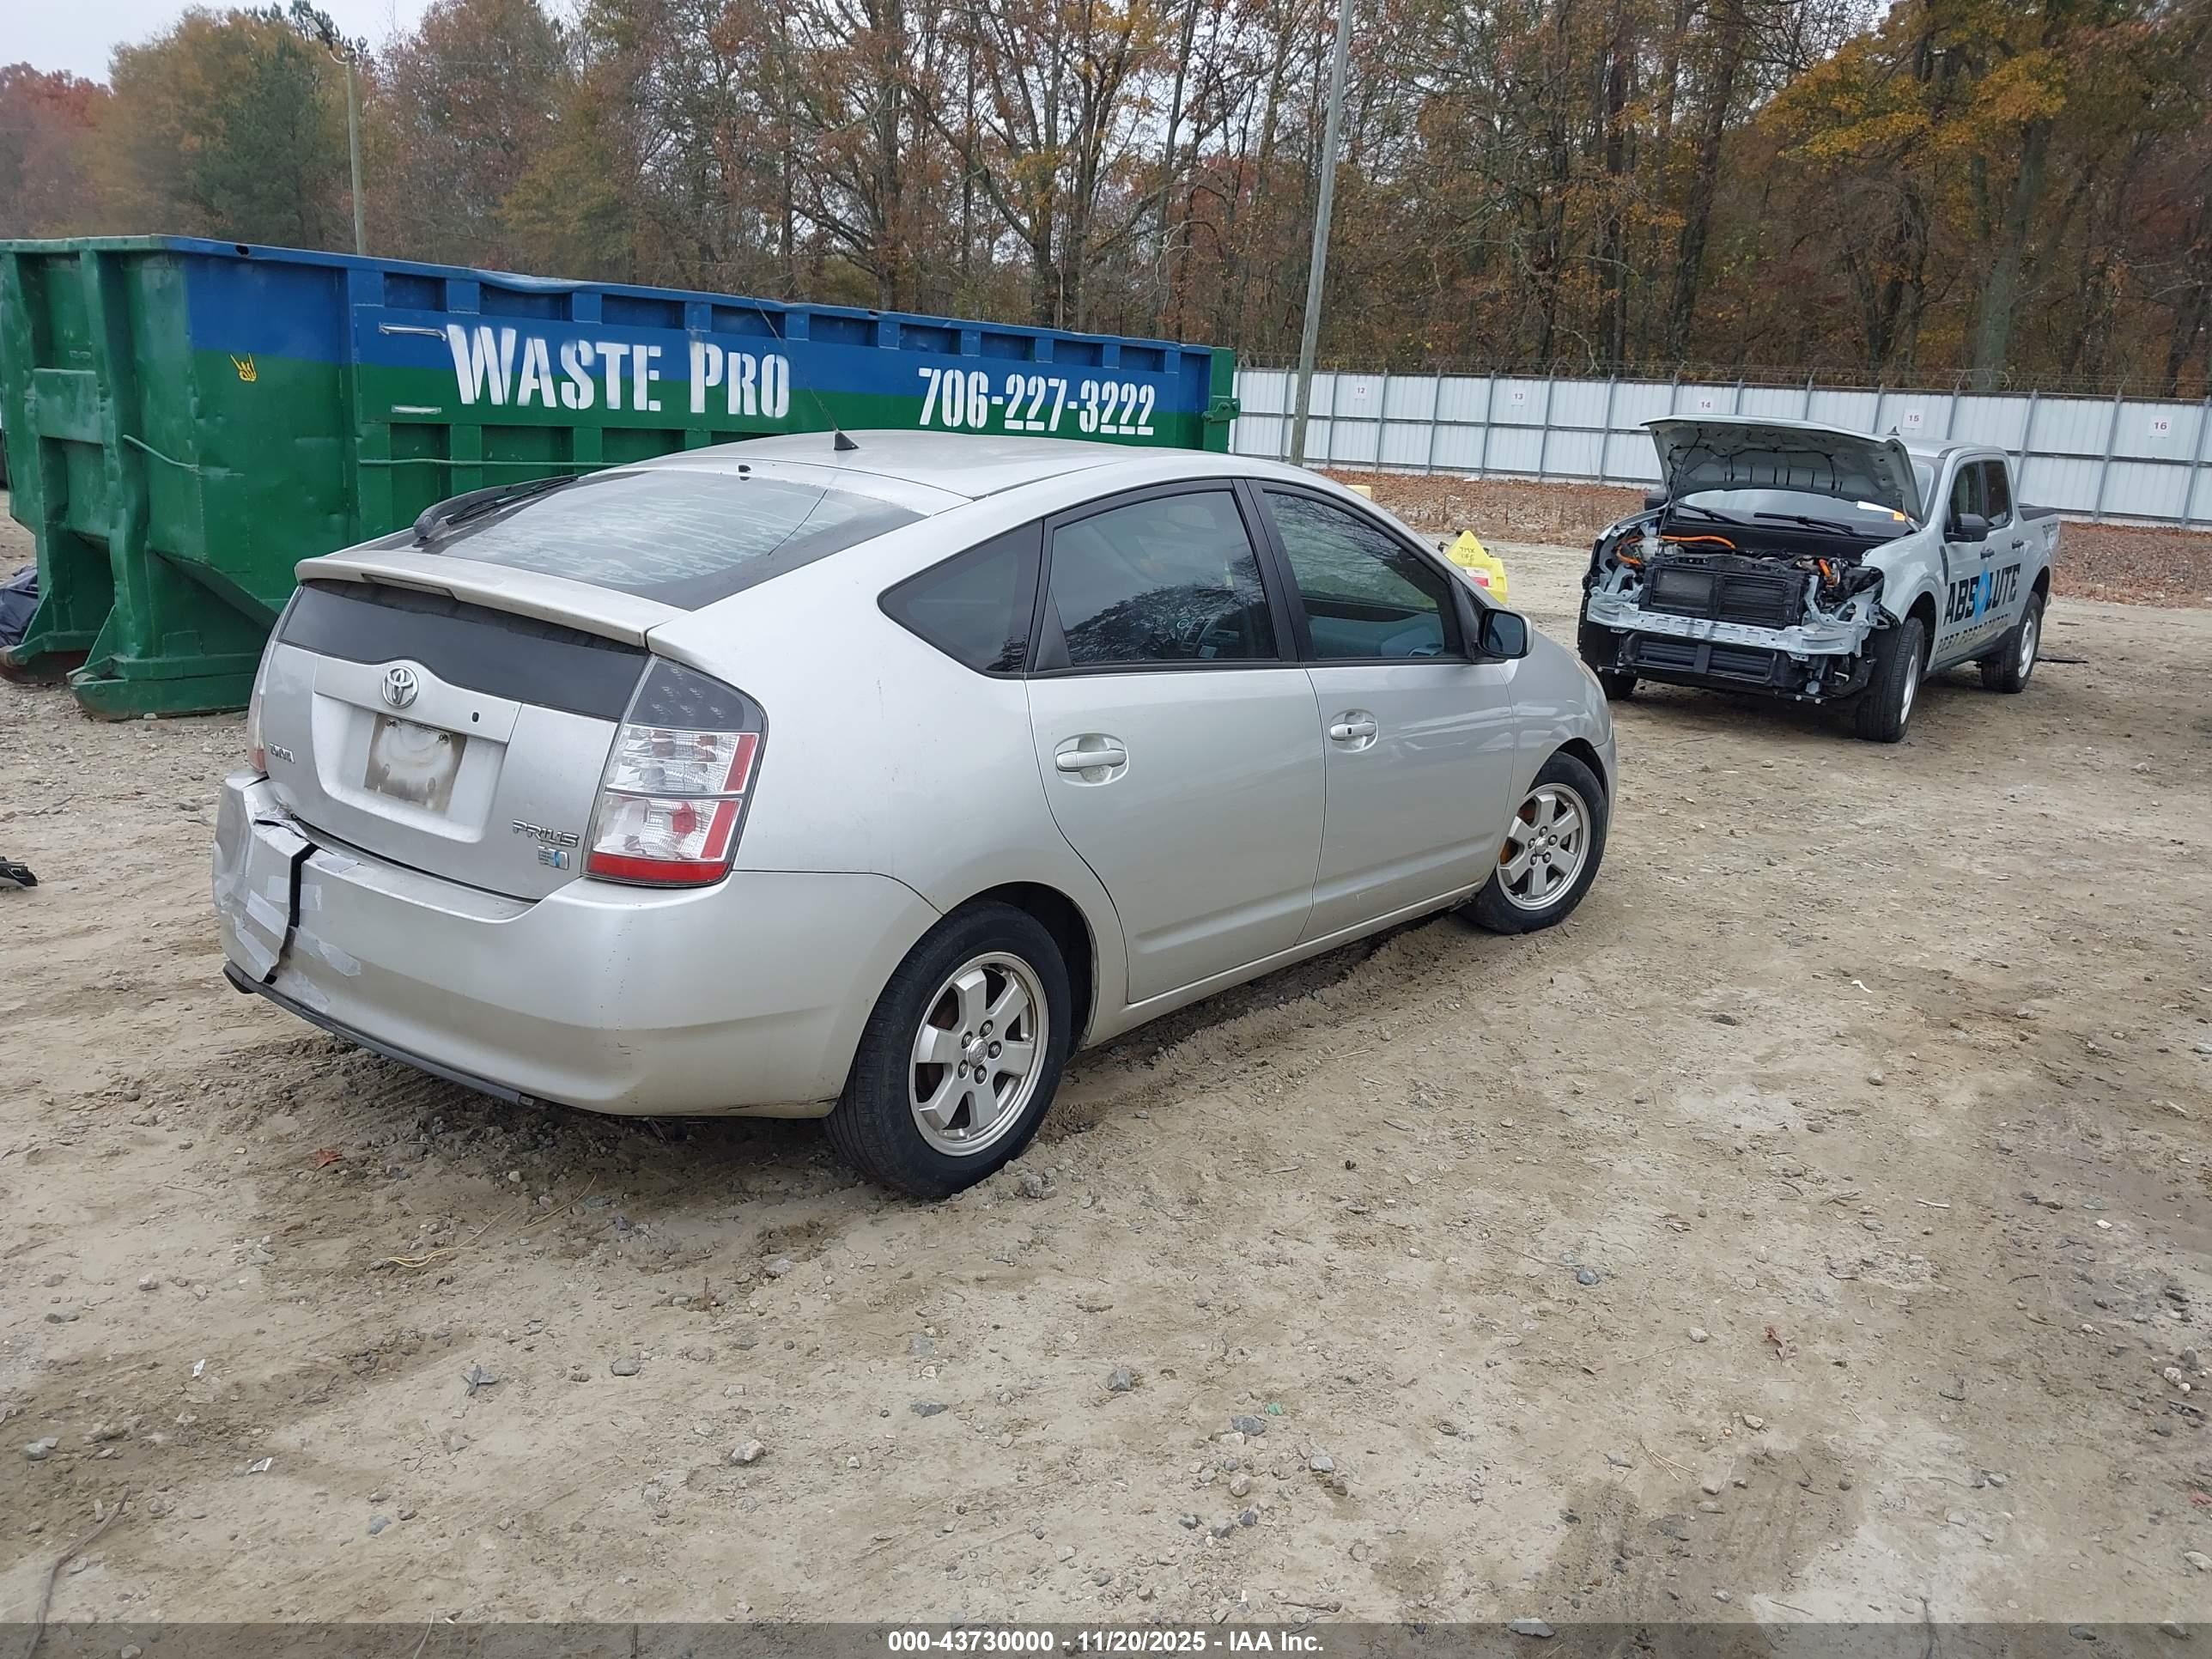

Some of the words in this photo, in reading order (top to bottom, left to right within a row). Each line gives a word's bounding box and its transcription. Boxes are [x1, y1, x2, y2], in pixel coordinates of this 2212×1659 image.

[447, 324, 661, 411] WASTE
[690, 342, 790, 418] PRO
[918, 368, 1155, 435] 706-227-3222
[2154, 422, 2167, 430] 16
[1942, 562, 2021, 628] ABSOLUTE
[513, 819, 579, 848] PRIUS
